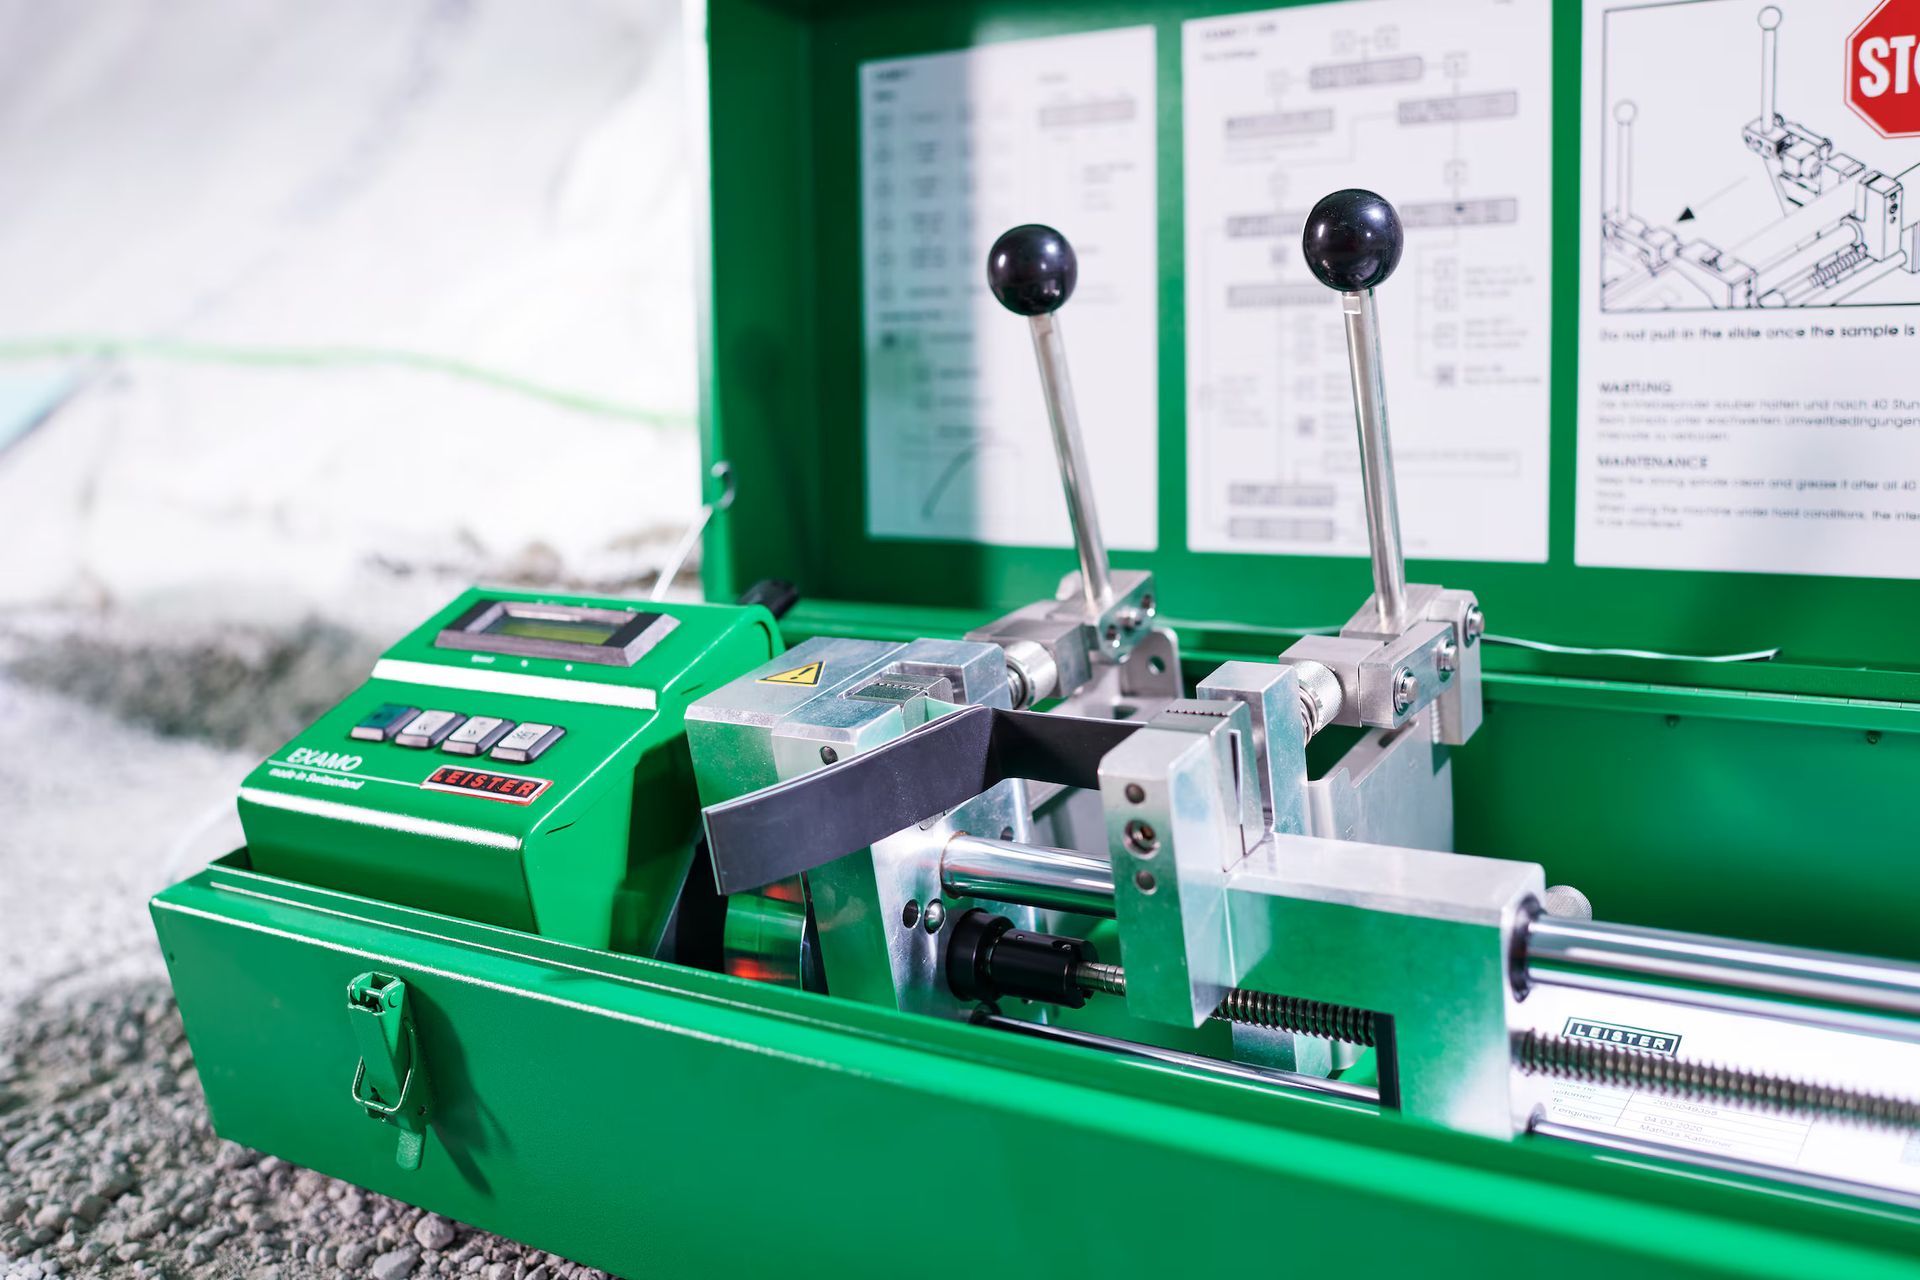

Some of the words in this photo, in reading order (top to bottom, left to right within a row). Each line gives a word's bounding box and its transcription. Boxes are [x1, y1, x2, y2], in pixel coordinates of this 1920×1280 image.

[1600, 329, 1618, 339] Do
[1623, 328, 1645, 339] not
[1650, 327, 1676, 341] pull
[1682, 327, 1694, 338] in
[1701, 326, 1722, 338] the
[1728, 326, 1760, 338] slide
[1766, 326, 1805, 338] once
[1811, 323, 1835, 336] the
[1841, 324, 1899, 338] sample
[1904, 323, 1916, 336] is
[1804, 400, 1829, 410] und
[1833, 400, 1868, 410] nach
[1872, 400, 1888, 410] 40
[1598, 456, 1708, 468] MAINTENANCE
[286, 747, 363, 771] EXAMO
[269, 768, 297, 780] made
[295, 771, 307, 781] in
[306, 772, 365, 790] Switzerland
[432, 769, 535, 796] LEISTER
[1575, 1024, 1666, 1050] LEISTER
